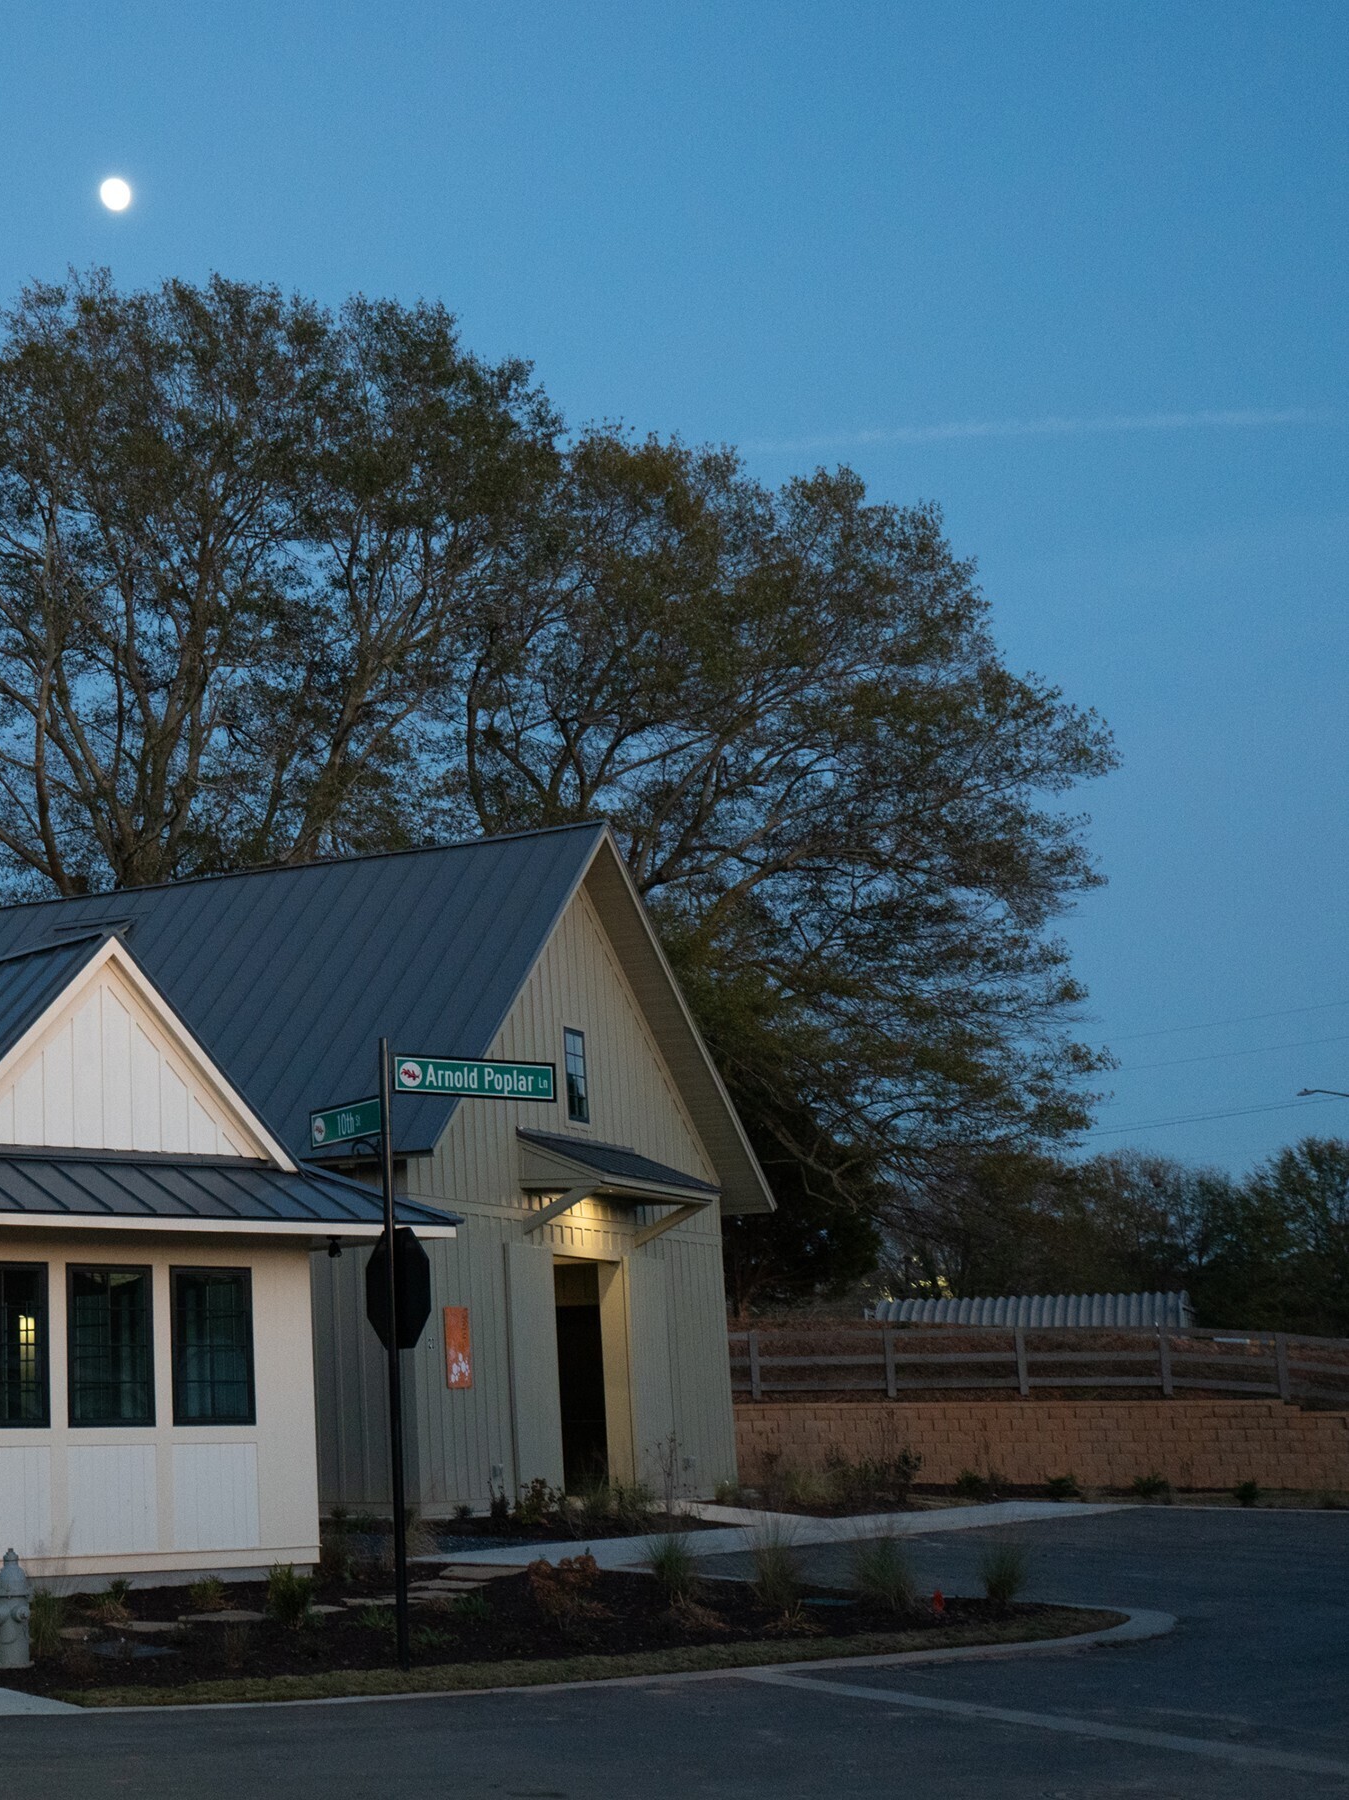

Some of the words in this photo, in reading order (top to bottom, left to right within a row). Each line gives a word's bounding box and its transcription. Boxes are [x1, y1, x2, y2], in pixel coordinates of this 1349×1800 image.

[425, 1063, 478, 1089] Arnold
[484, 1067, 534, 1095] Poplar
[538, 1076, 549, 1089] Ln
[337, 1111, 355, 1137] 10th
